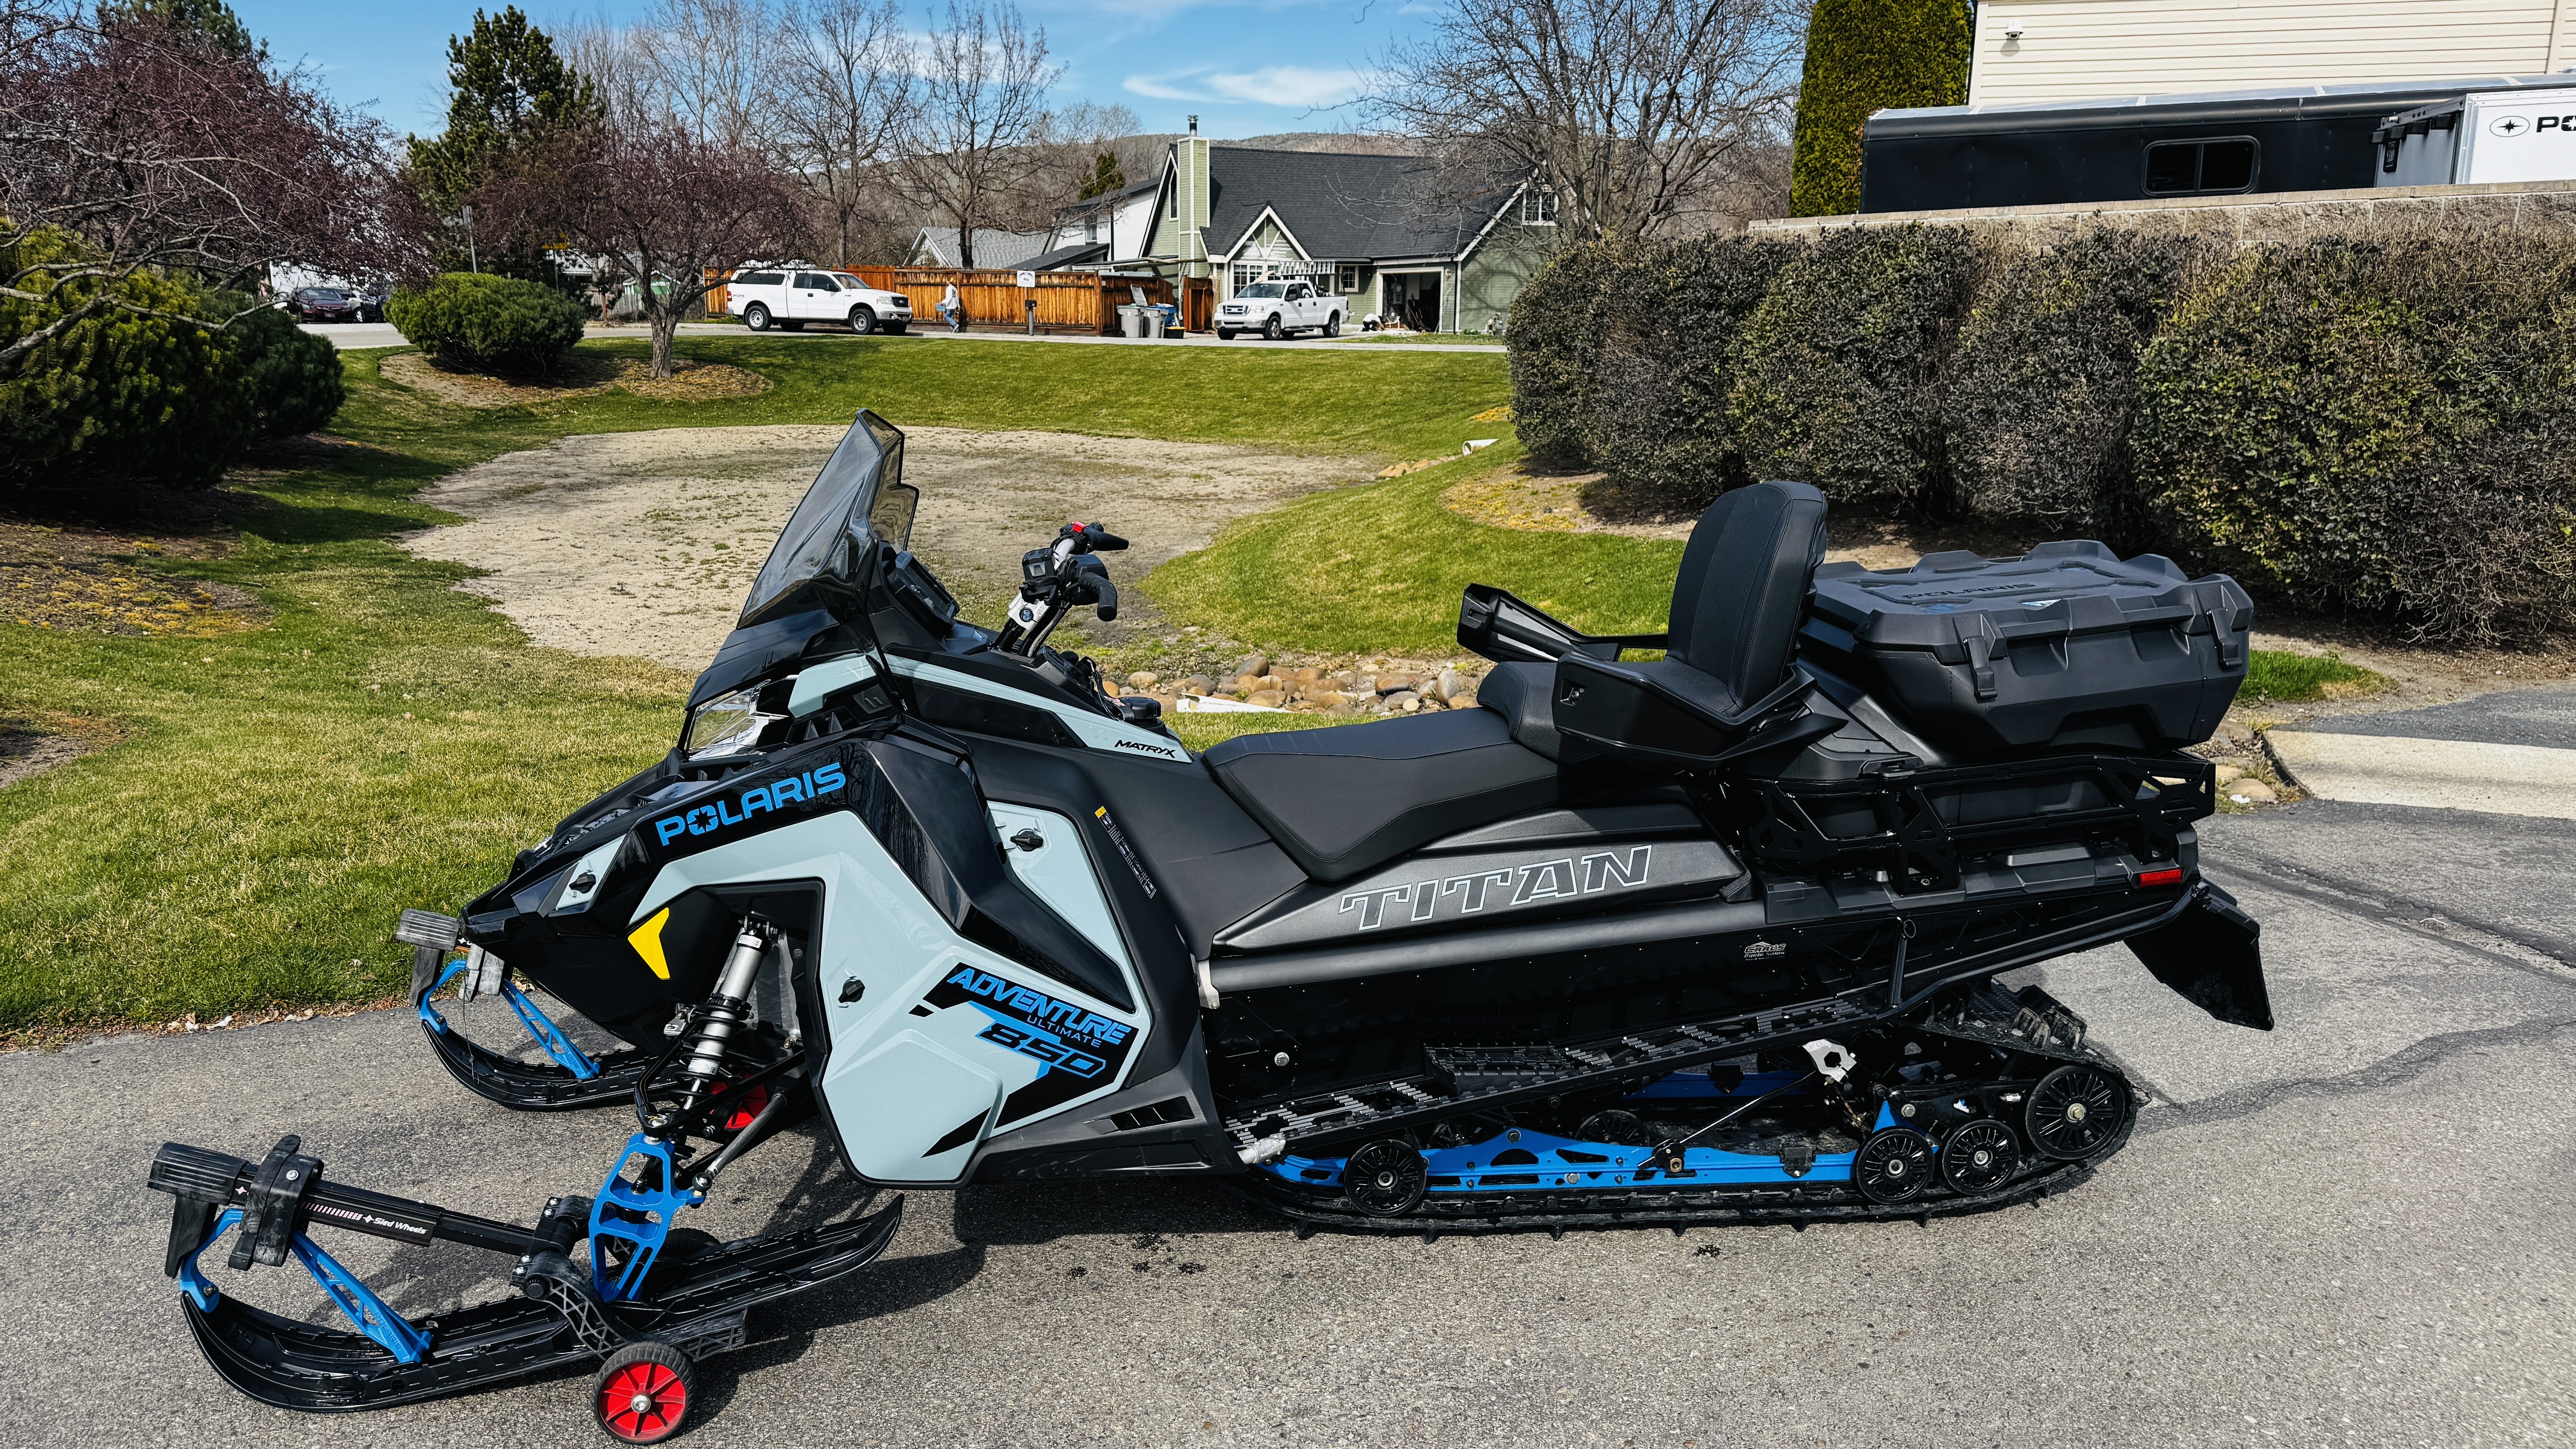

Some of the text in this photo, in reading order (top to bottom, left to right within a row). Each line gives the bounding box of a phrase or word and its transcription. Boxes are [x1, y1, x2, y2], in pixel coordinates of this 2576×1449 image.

[1901, 583, 2035, 599] POLARIS
[1114, 739, 1176, 759] MATRYX
[655, 762, 846, 846] POLARIS
[1339, 844, 1653, 931] TITAN
[947, 968, 1132, 1045] ADVENTURE
[975, 1021, 1107, 1078] 850
[1027, 1015, 1102, 1048] ULTIMATE
[373, 1217, 427, 1234] Sled Wheels
[374, 1311, 402, 1350] POLARIS
